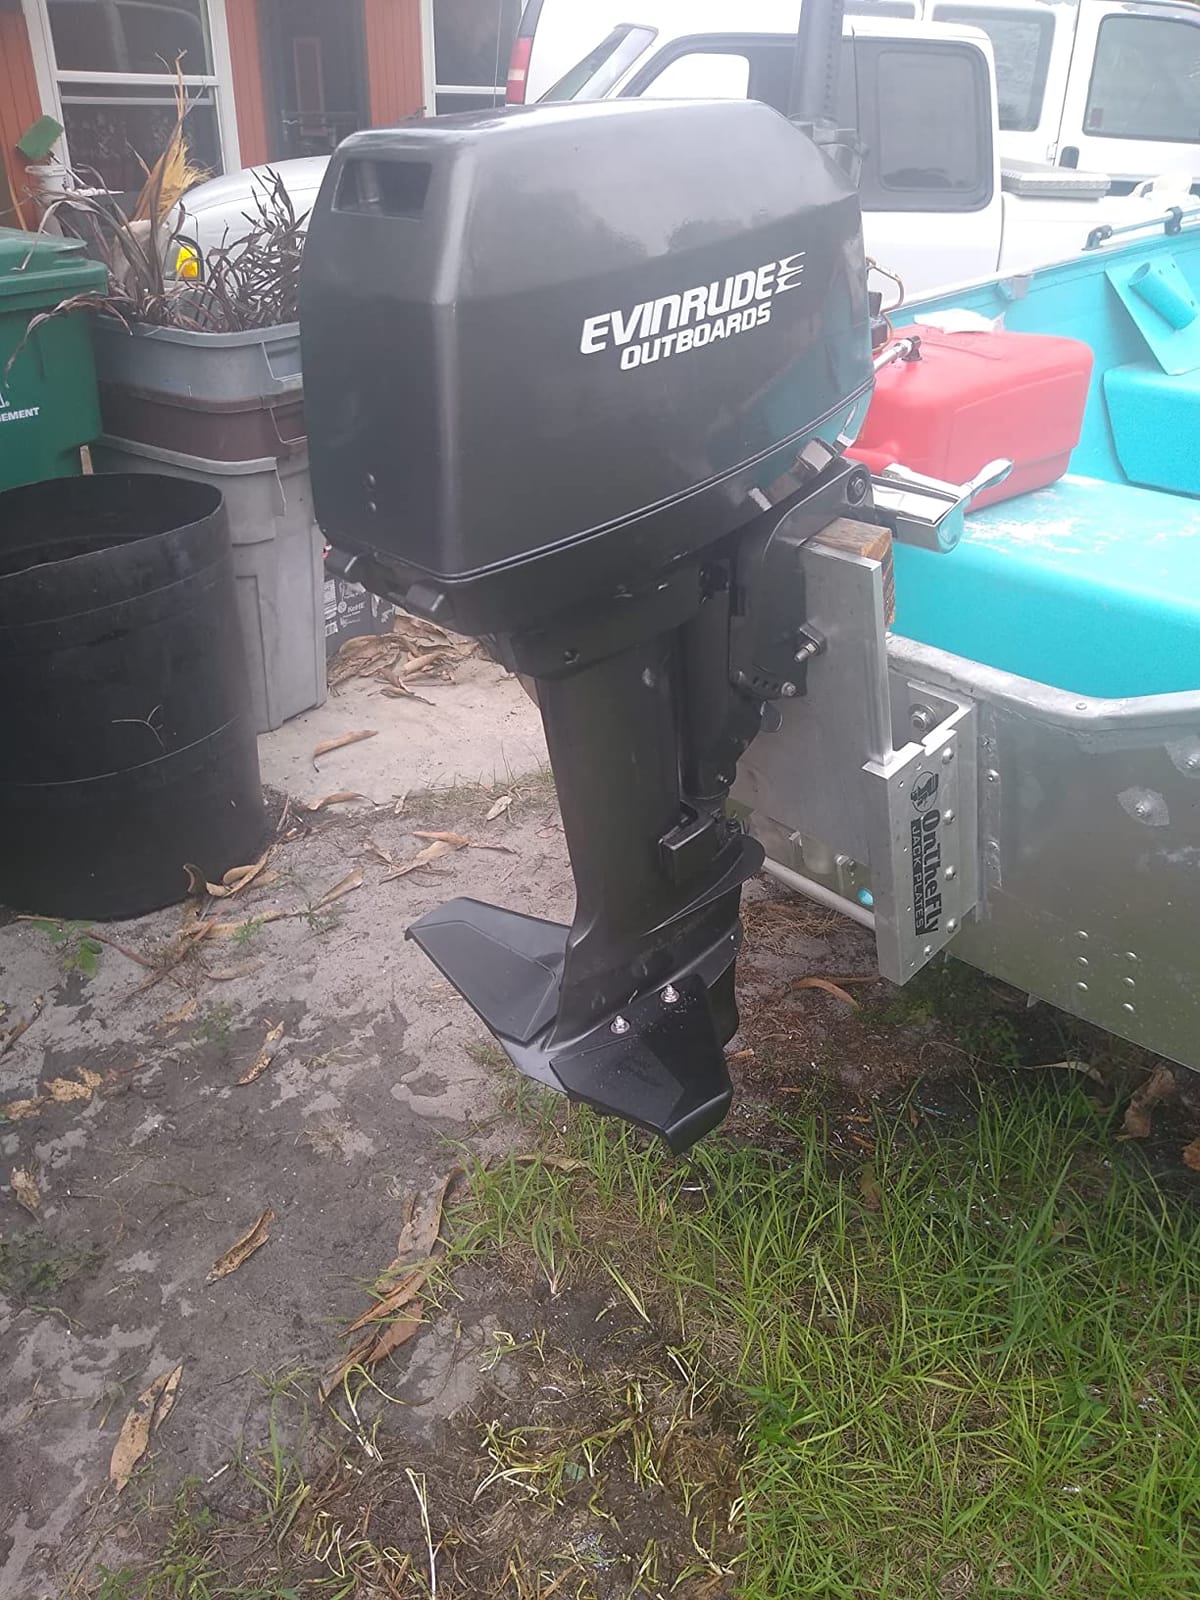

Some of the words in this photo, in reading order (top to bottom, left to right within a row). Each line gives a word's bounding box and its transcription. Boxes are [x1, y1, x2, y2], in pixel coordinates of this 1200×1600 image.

[580, 262, 778, 355] EVINRUDE
[620, 301, 772, 371] OUTBOARDS
[0, 407, 40, 422] EMENT
[911, 825, 923, 866] JACK
[914, 872, 925, 929] PLATES
